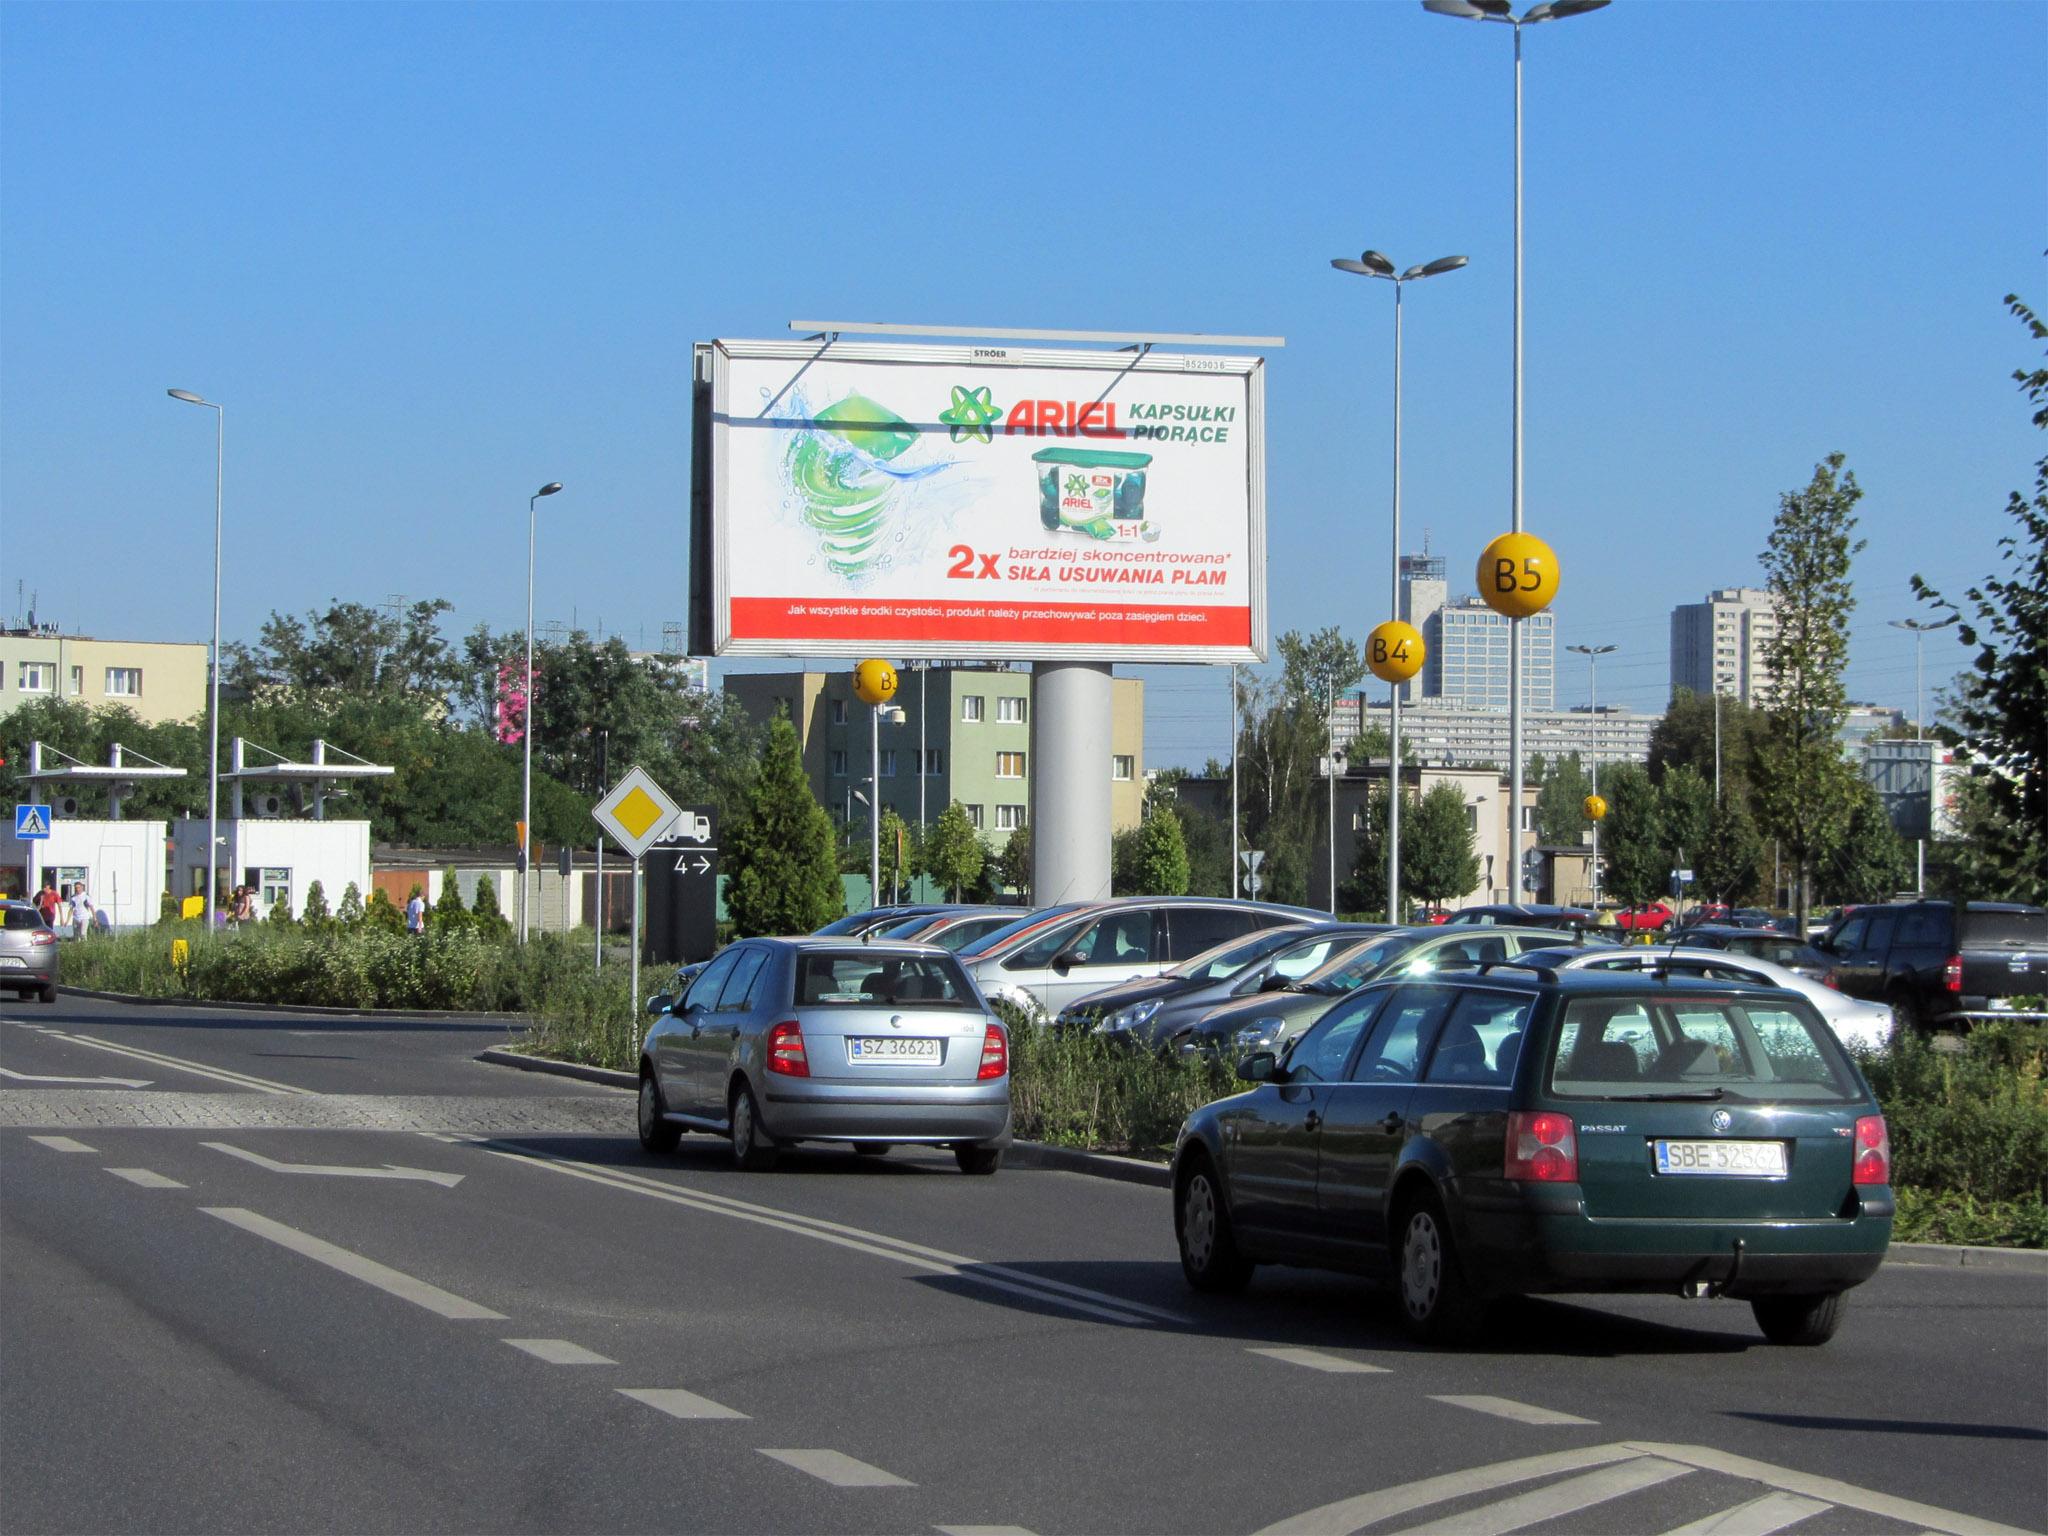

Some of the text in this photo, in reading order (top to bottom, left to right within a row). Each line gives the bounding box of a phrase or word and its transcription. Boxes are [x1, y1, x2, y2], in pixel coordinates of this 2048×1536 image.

[974, 350, 1006, 358] STRÖER
[1004, 399, 1126, 440] ARIEL
[1129, 403, 1236, 423] KAPSUŁKI
[1133, 424, 1229, 447] PIORĄCE
[1062, 497, 1093, 509] ARIEL
[946, 544, 1002, 580] 2x
[1008, 547, 1077, 563] bardziej
[1007, 565, 1227, 585] SIŁA USUWANIA PLAM
[1495, 558, 1541, 592] B5
[788, 605, 1208, 624] Jak wszystkie środki czystości, produkt należy przechowywać poza zasięgiem dzieci.
[1373, 638, 1408, 663] B4
[674, 855, 688, 874] 4
[863, 1040, 934, 1055] SZ 36623
[1669, 1145, 1711, 1167] SBE
